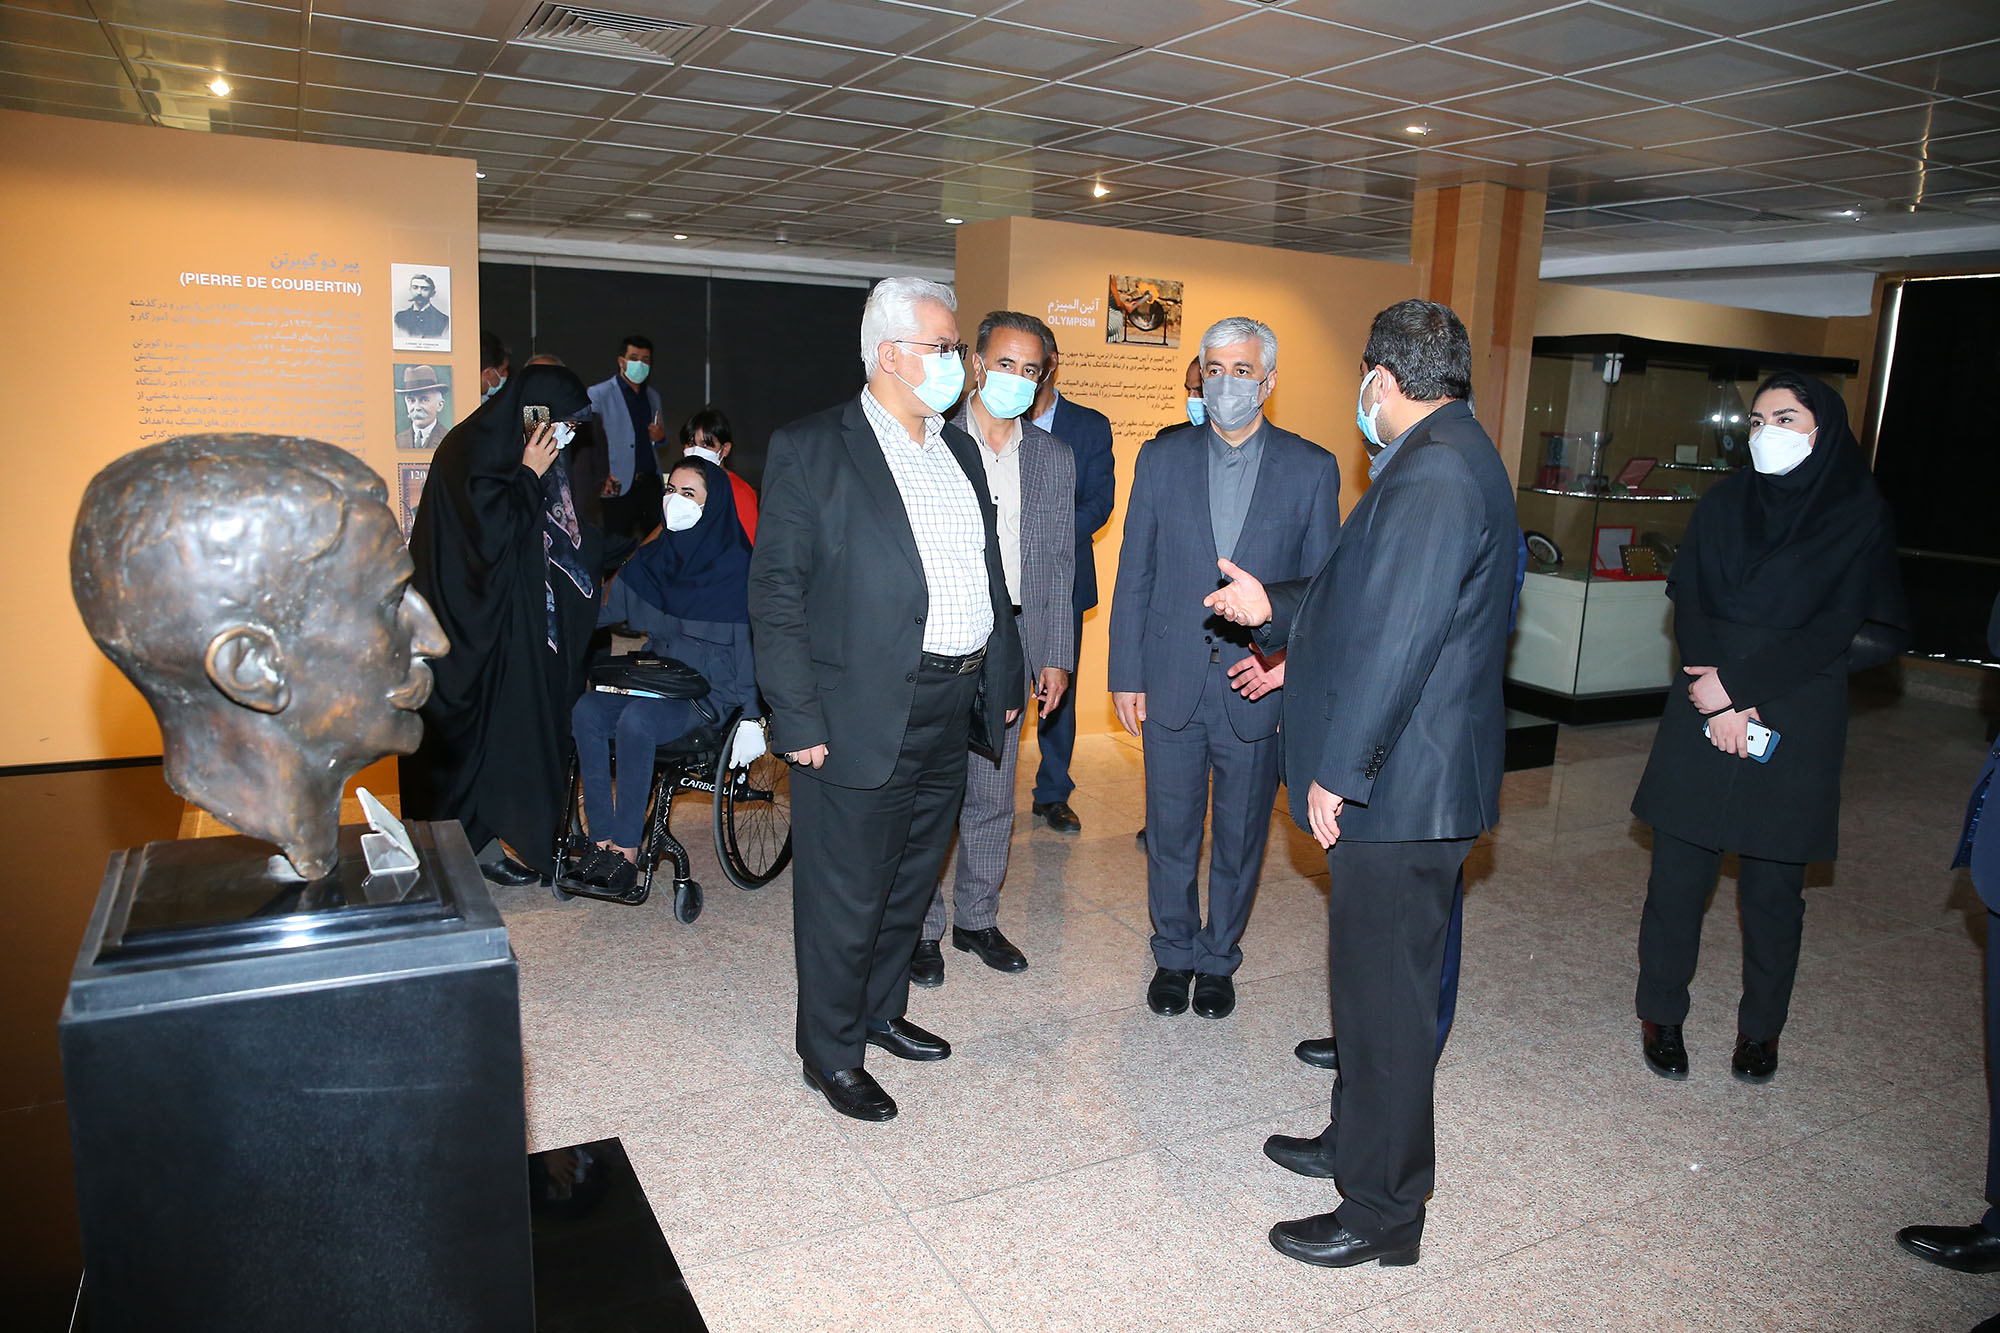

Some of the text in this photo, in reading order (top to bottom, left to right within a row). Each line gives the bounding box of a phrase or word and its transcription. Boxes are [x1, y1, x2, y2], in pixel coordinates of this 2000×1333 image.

[179, 272, 362, 296] (PIERRE DE COUBERTIN)
[1047, 315, 1096, 327] OLYMPISM
